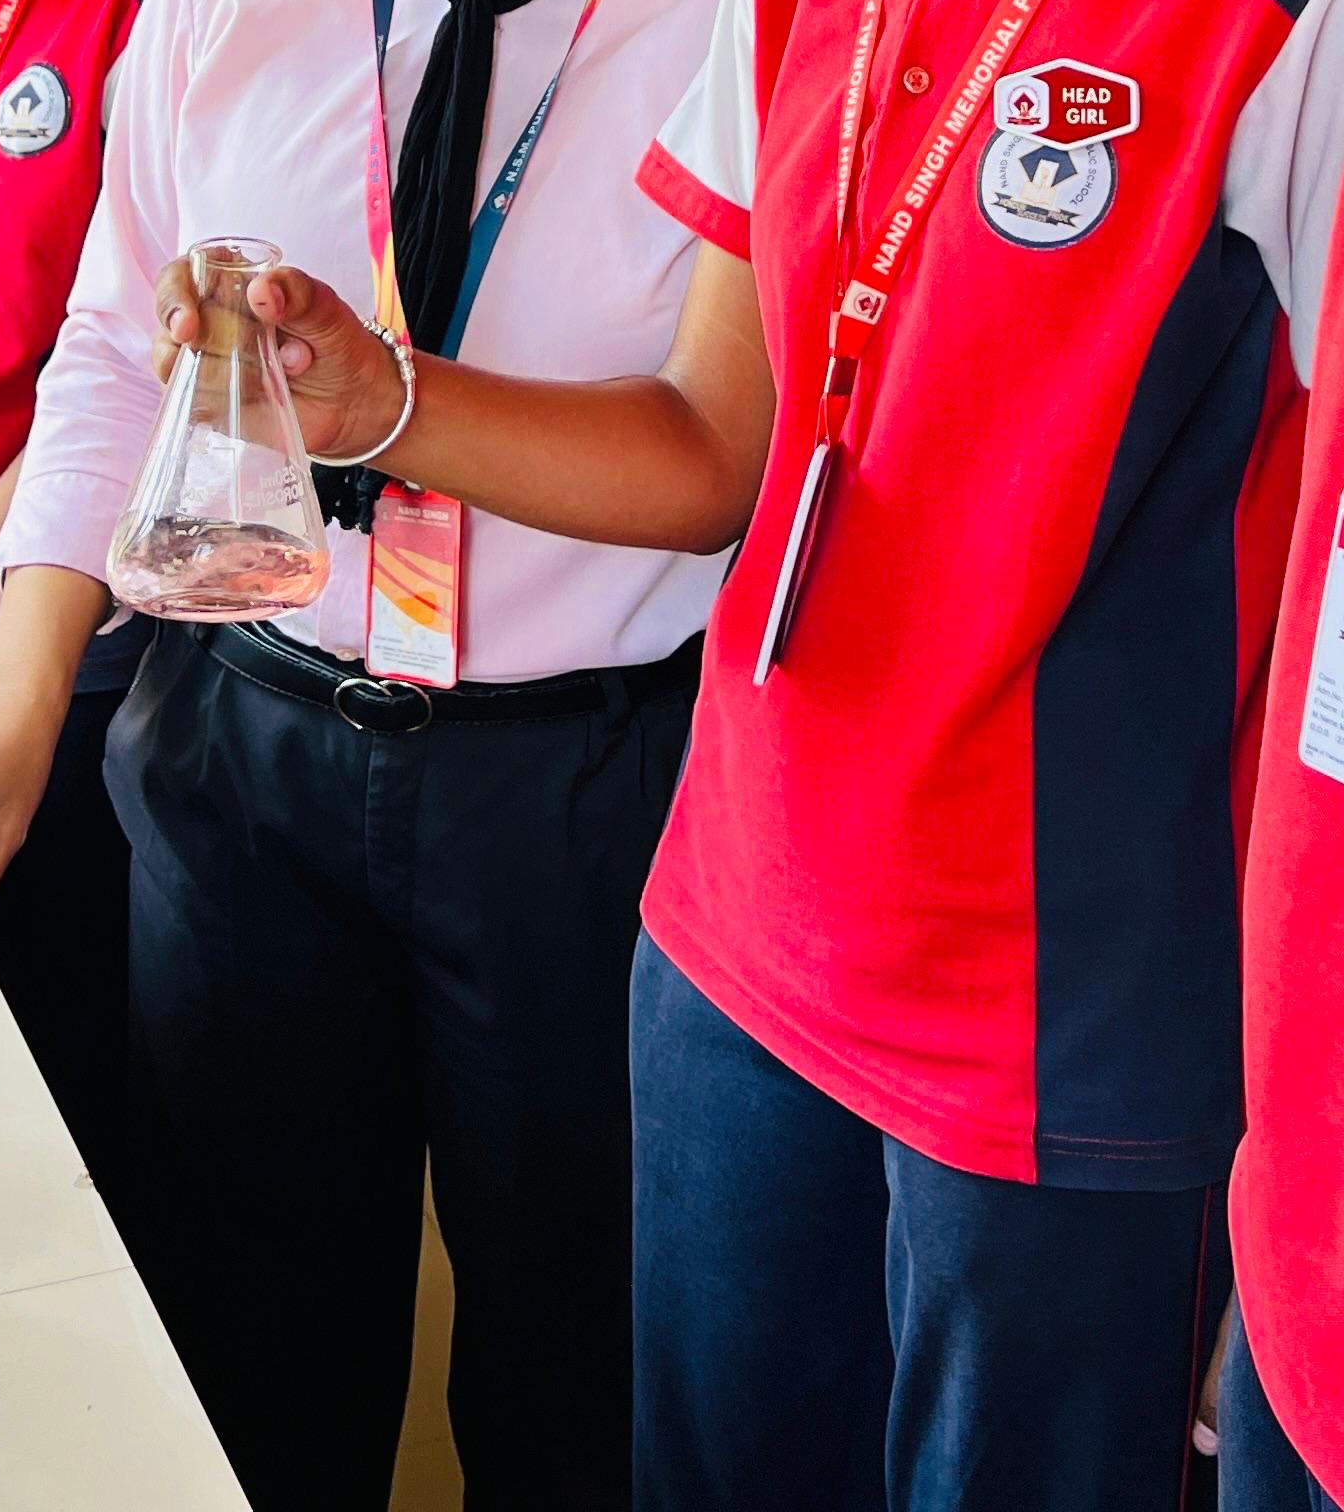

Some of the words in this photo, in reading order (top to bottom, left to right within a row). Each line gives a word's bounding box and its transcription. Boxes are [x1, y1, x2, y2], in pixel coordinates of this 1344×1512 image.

[1062, 88, 1112, 104] HEAD
[1065, 108, 1108, 125] GIRL
[871, 219, 914, 276] NAND
[905, 135, 955, 210] SINGH
[951, 17, 1023, 135] MEMORIAL
[1005, 134, 1023, 159] SING
